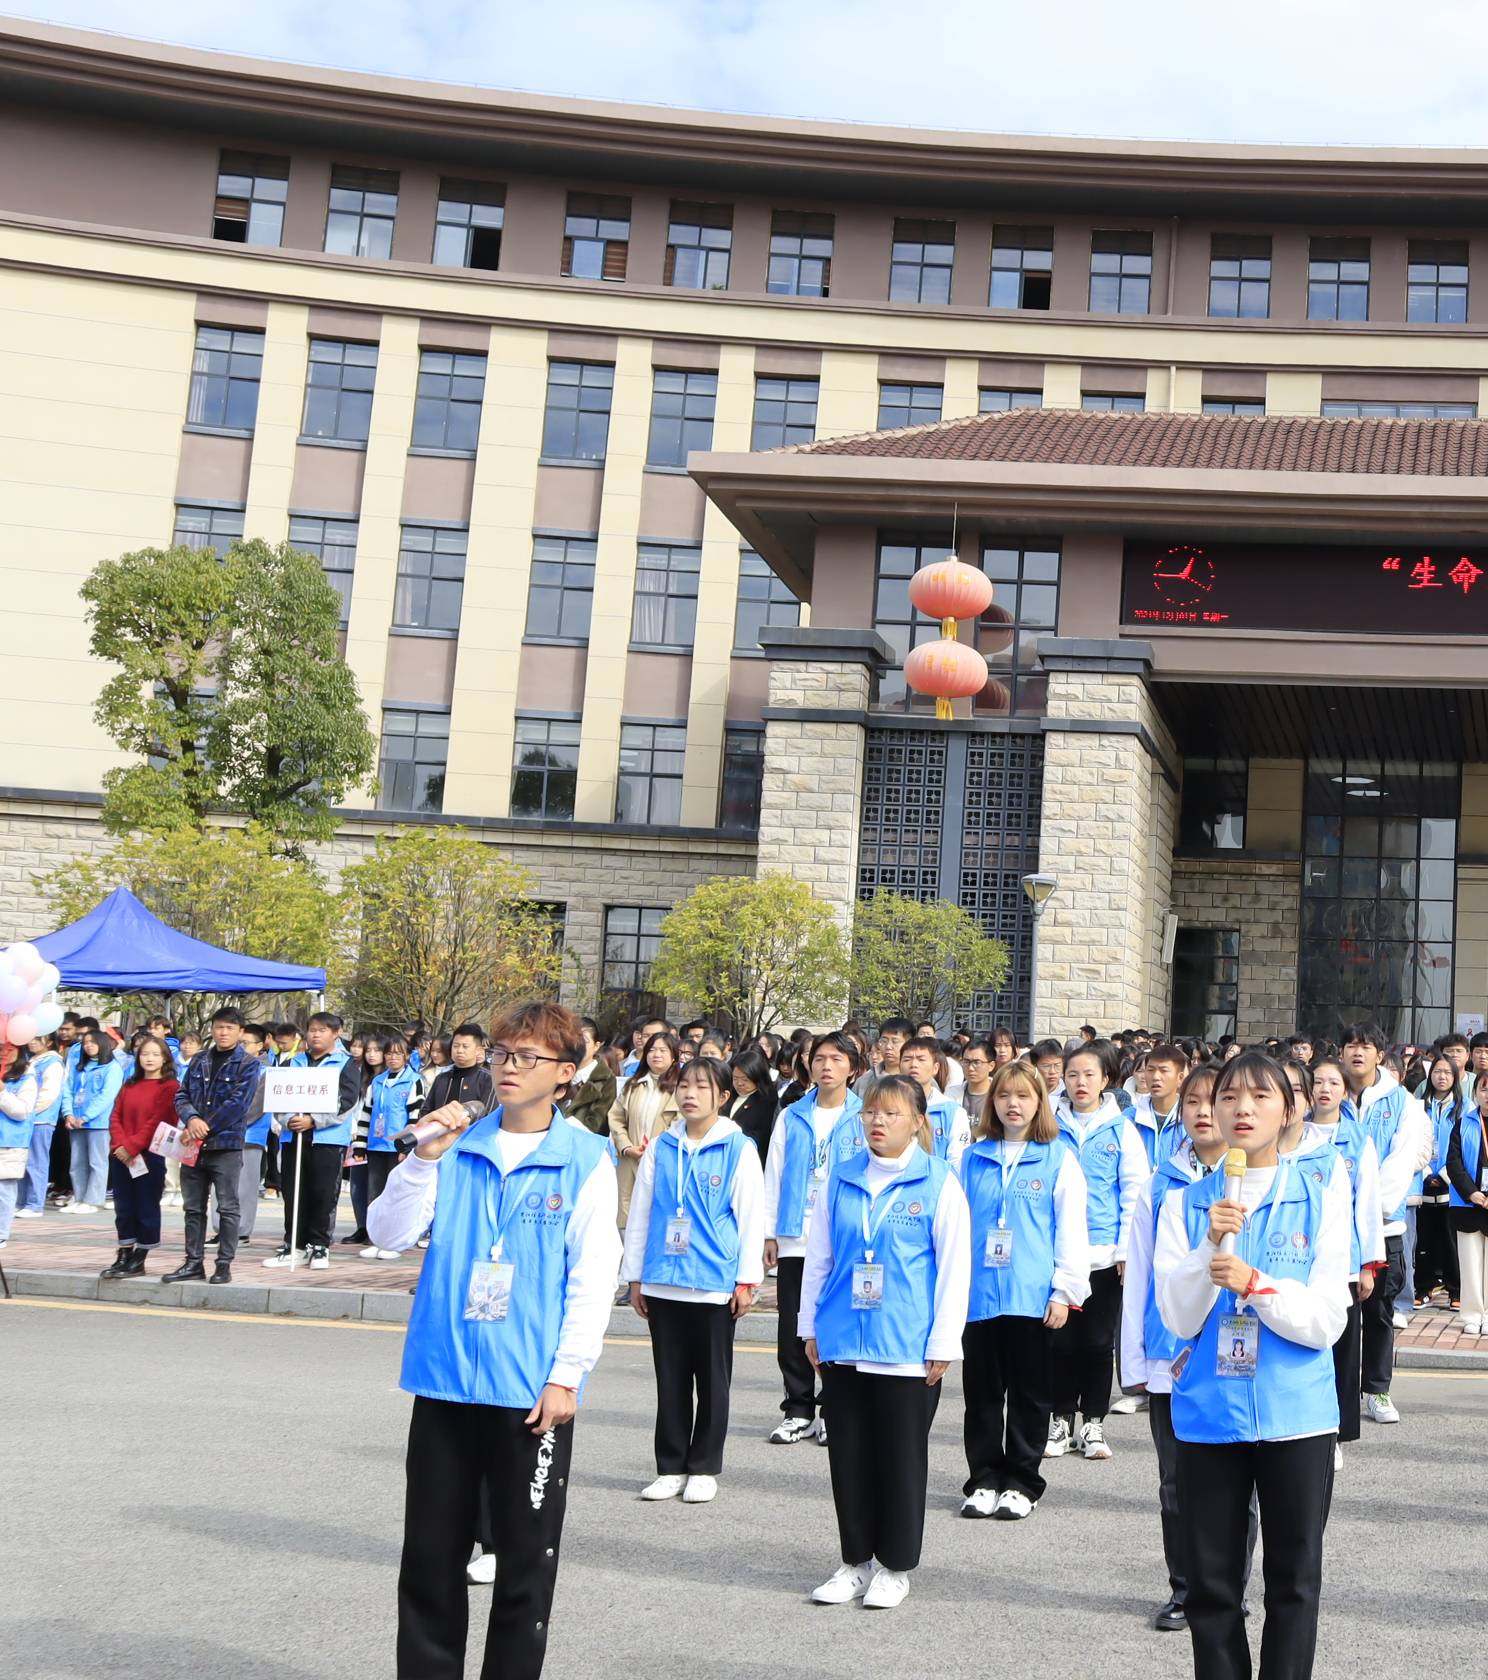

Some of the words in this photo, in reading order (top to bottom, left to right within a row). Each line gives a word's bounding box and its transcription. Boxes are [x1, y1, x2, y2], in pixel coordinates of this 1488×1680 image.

[273, 1084, 329, 1096] 信息工程系
